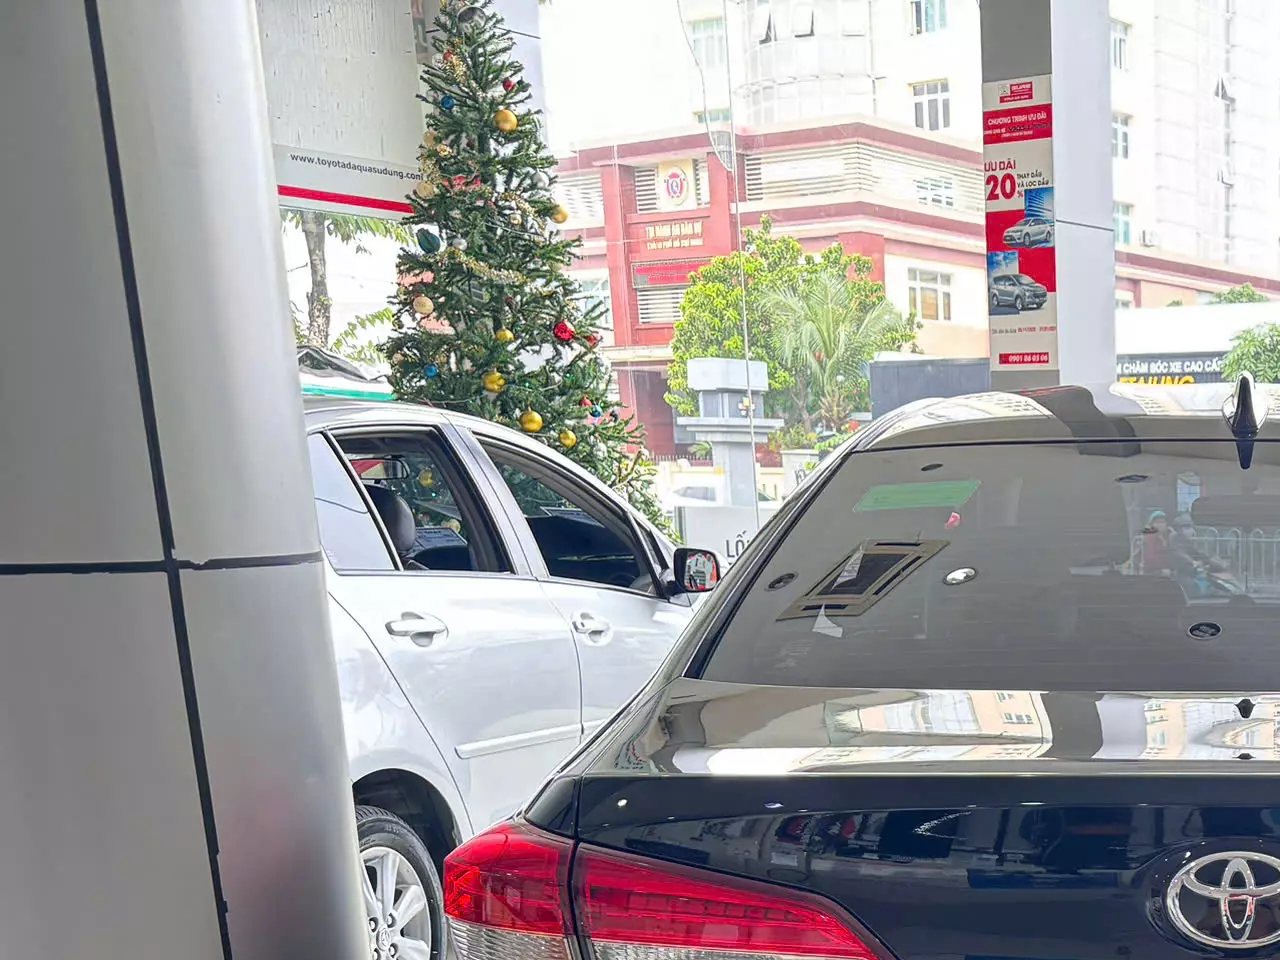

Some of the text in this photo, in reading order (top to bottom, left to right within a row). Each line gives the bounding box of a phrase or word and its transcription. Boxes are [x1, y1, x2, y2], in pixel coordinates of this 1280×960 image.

[985, 173, 1016, 201] 20
[1170, 361, 1182, 373] XE
[1183, 361, 1204, 373] CAO
